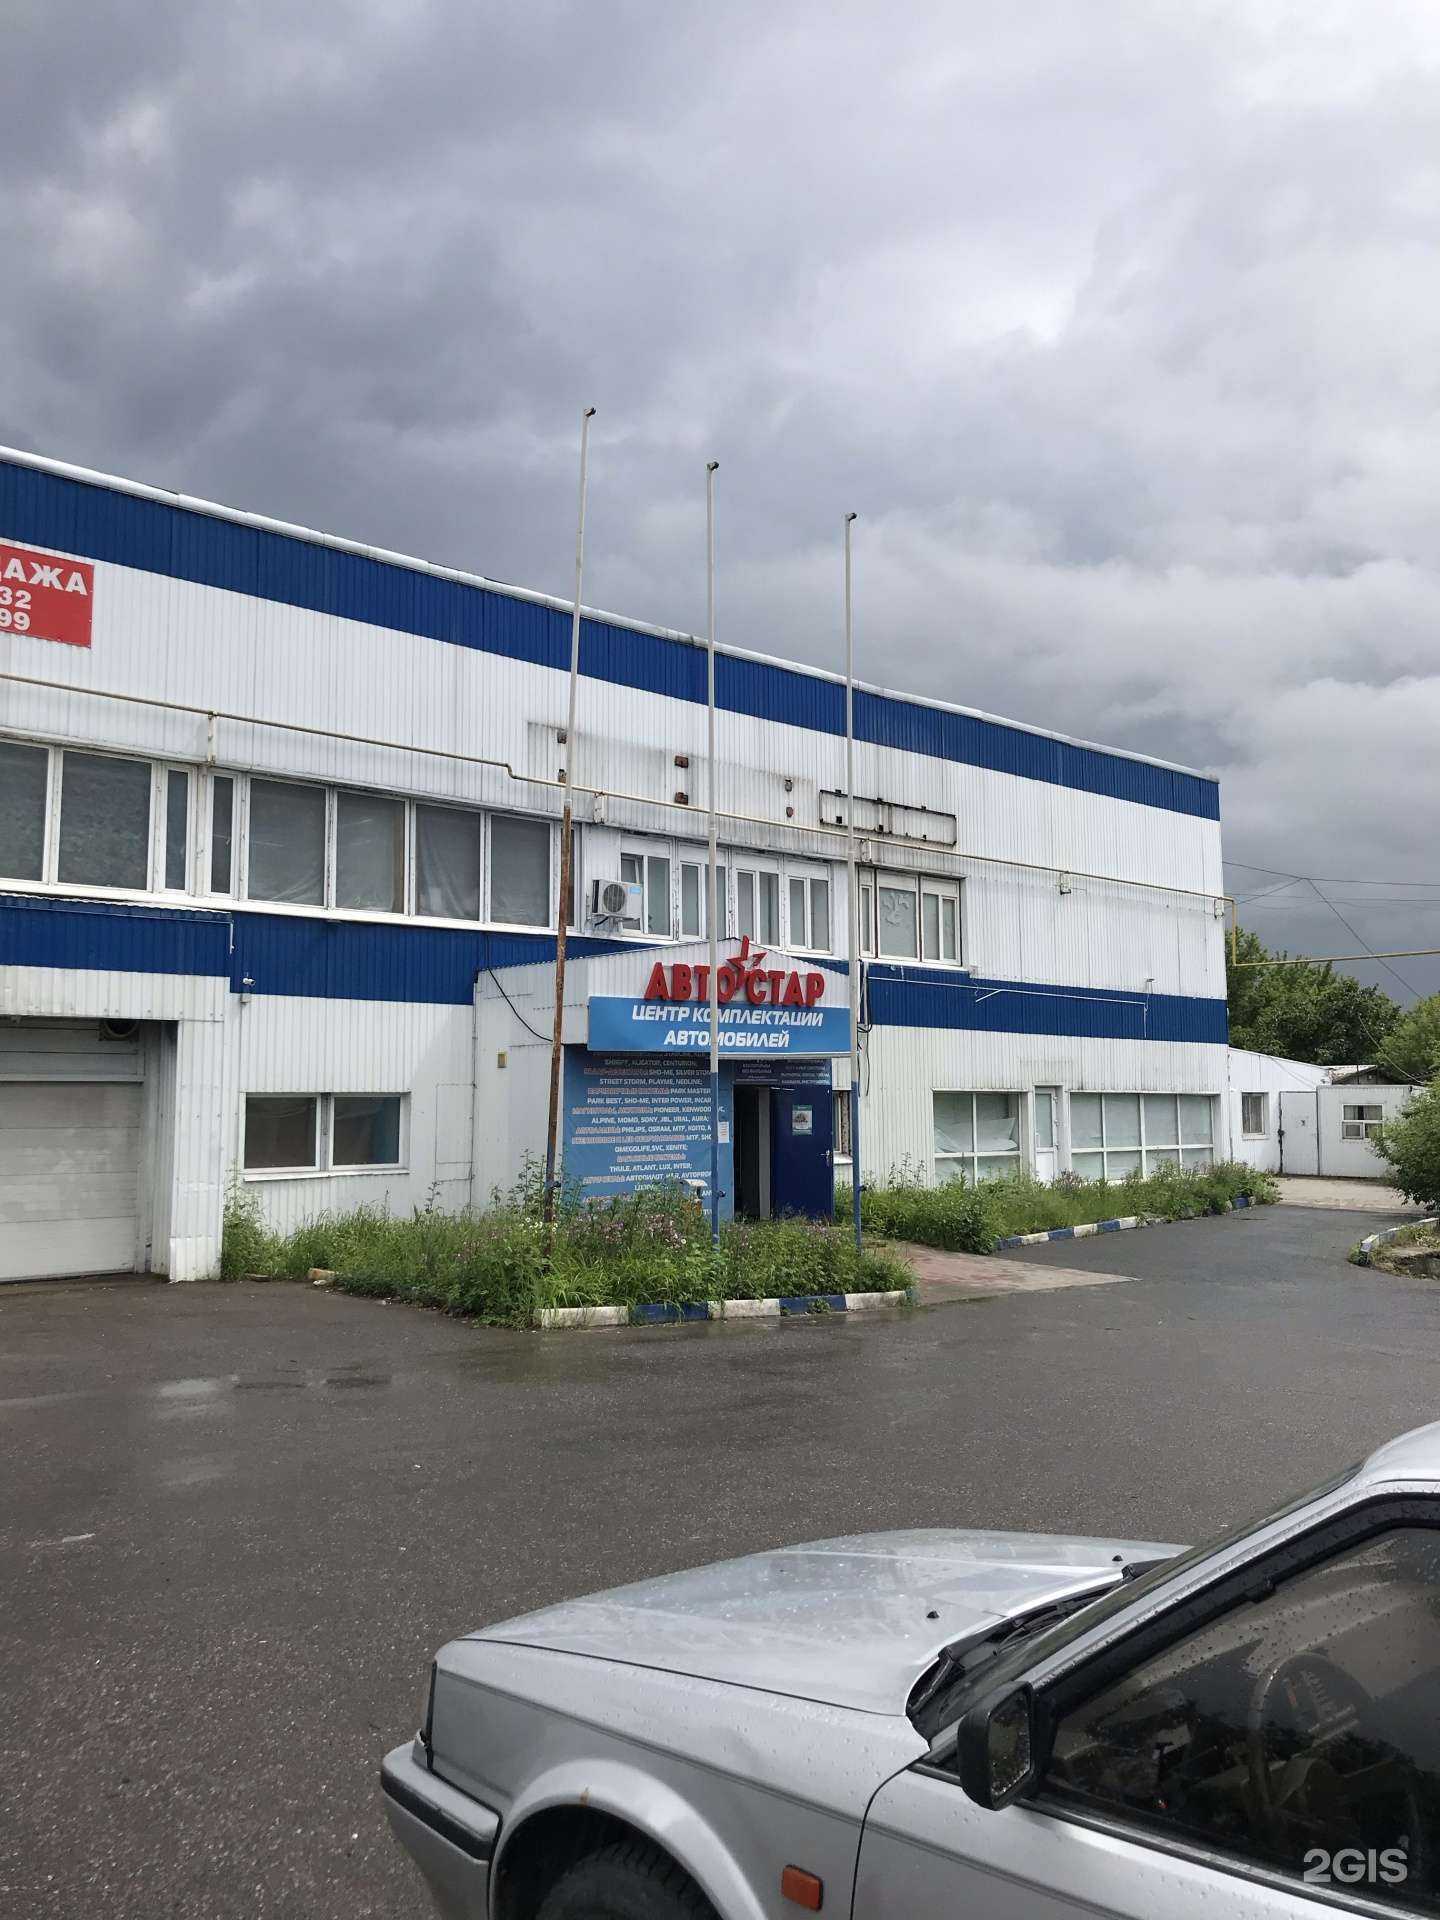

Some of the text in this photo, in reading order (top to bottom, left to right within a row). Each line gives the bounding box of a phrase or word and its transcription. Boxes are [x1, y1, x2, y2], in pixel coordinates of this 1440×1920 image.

[0, 558, 87, 595] АЖА
[632, 1004, 824, 1027] ЦЕНТР КОМПЛЕКТАЦИИ
[664, 1029, 790, 1048] АВТОМОБИЛЕЙ
